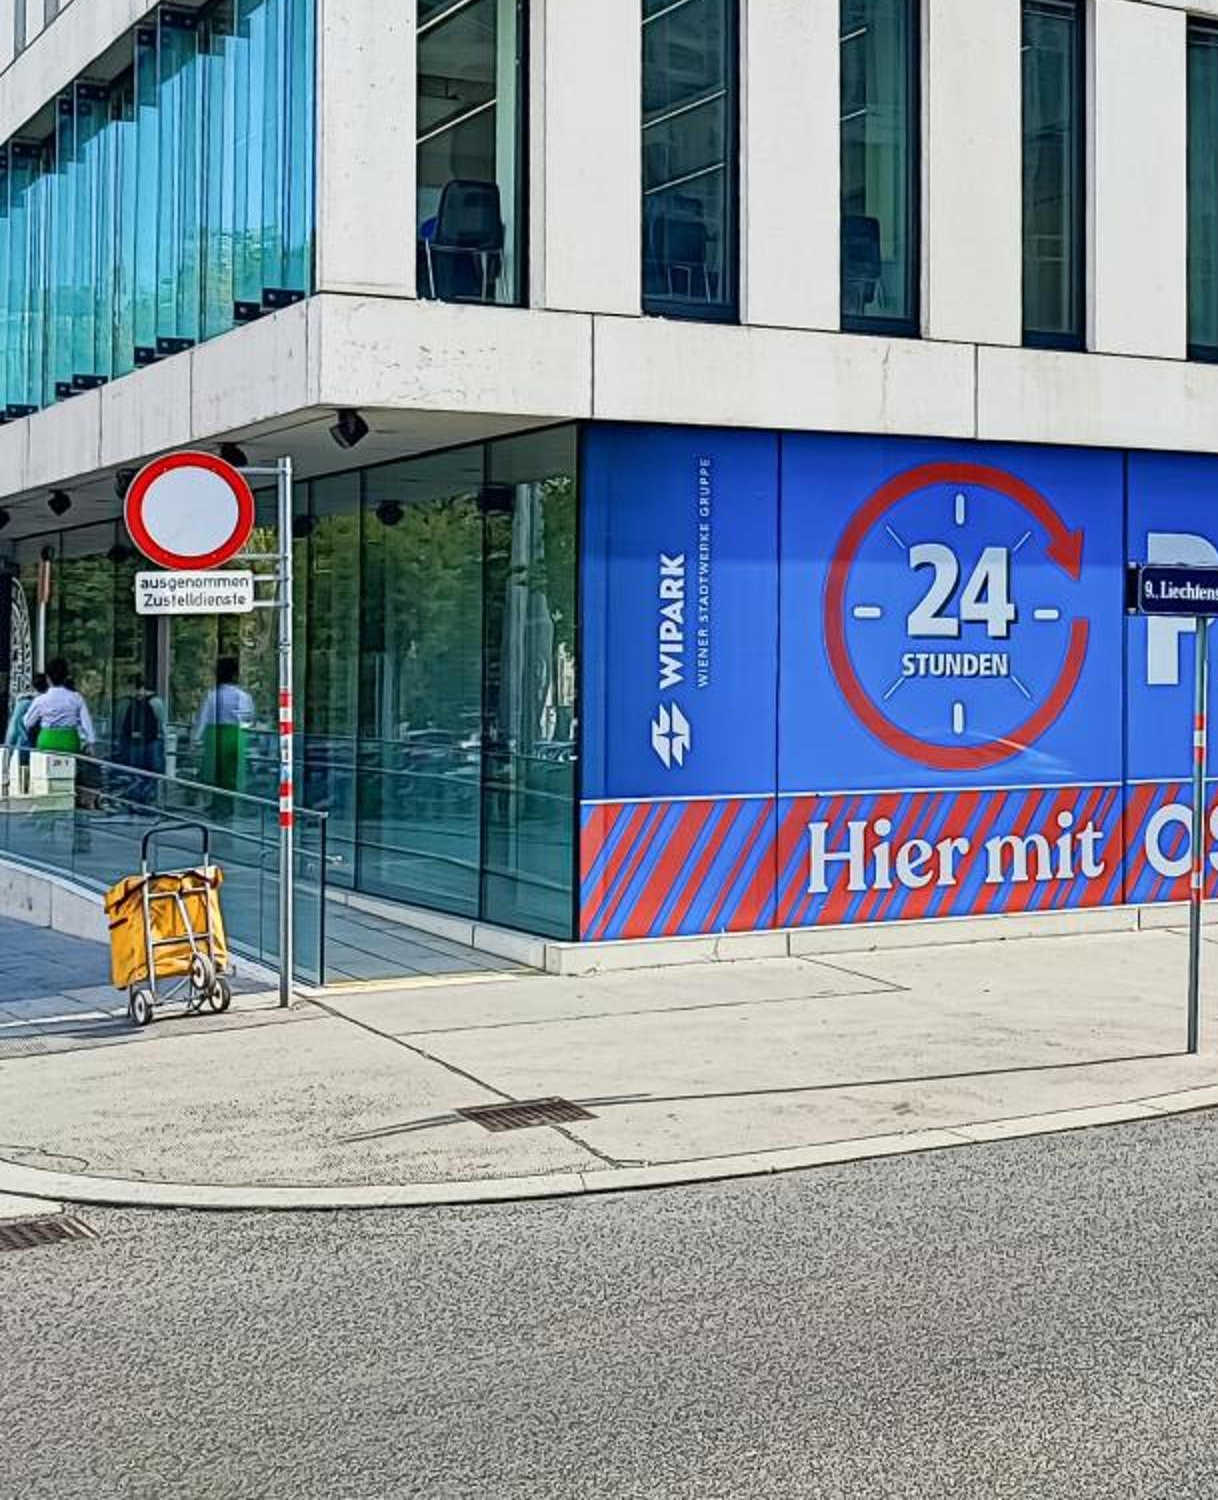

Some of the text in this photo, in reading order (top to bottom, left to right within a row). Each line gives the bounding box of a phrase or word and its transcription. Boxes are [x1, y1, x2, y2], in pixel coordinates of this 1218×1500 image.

[140, 576, 250, 592] ausgenommen
[142, 592, 247, 608] Zustelldienste
[697, 457, 712, 689] WIENER STADTWERKE GRUPPE
[907, 542, 1017, 639] 24
[659, 553, 685, 690] WIPARK
[901, 652, 1010, 678] STUNDEN
[807, 817, 971, 894] Hier
[985, 810, 1106, 884] mit
